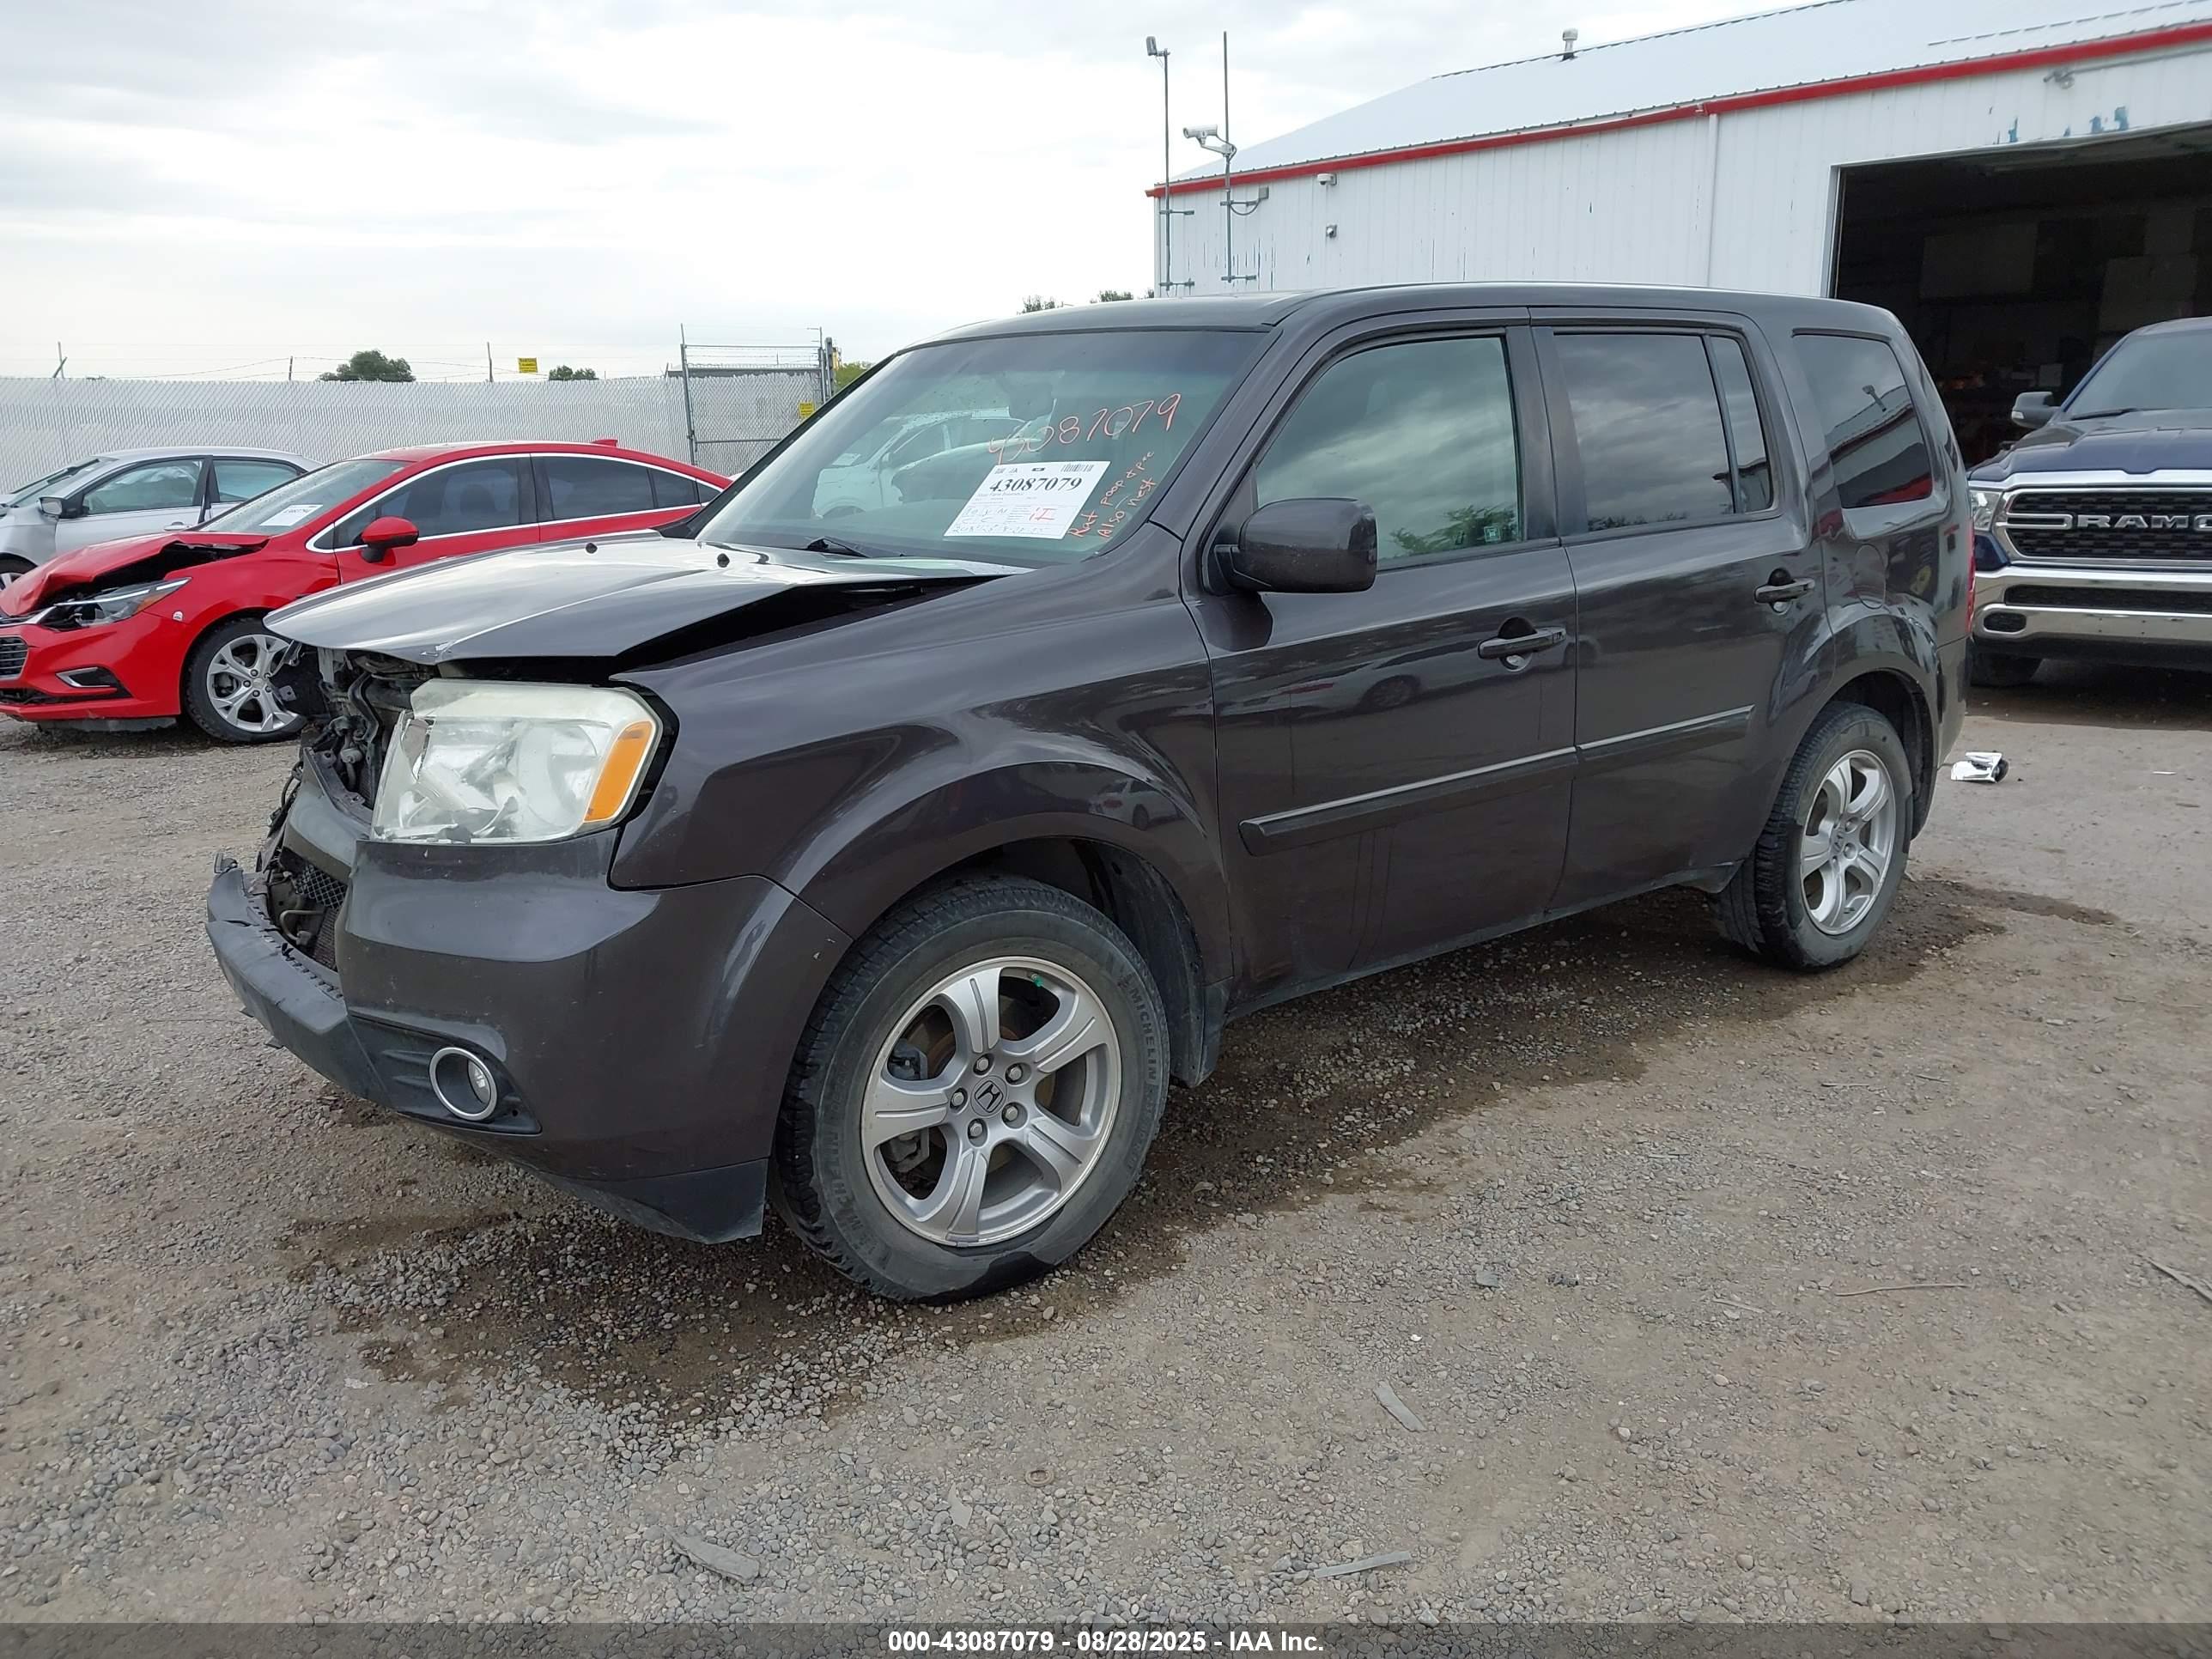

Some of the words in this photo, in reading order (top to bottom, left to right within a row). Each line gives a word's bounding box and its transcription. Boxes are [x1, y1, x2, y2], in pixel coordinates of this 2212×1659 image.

[988, 392, 1182, 465] 43087079
[989, 477, 1083, 492] 43087079
[1127, 477, 1157, 507] nest
[1068, 510, 1098, 537] Rat
[1100, 480, 1126, 506] poop
[2077, 514, 2190, 529] RAM
[1130, 987, 1158, 1081] MICHELIN
